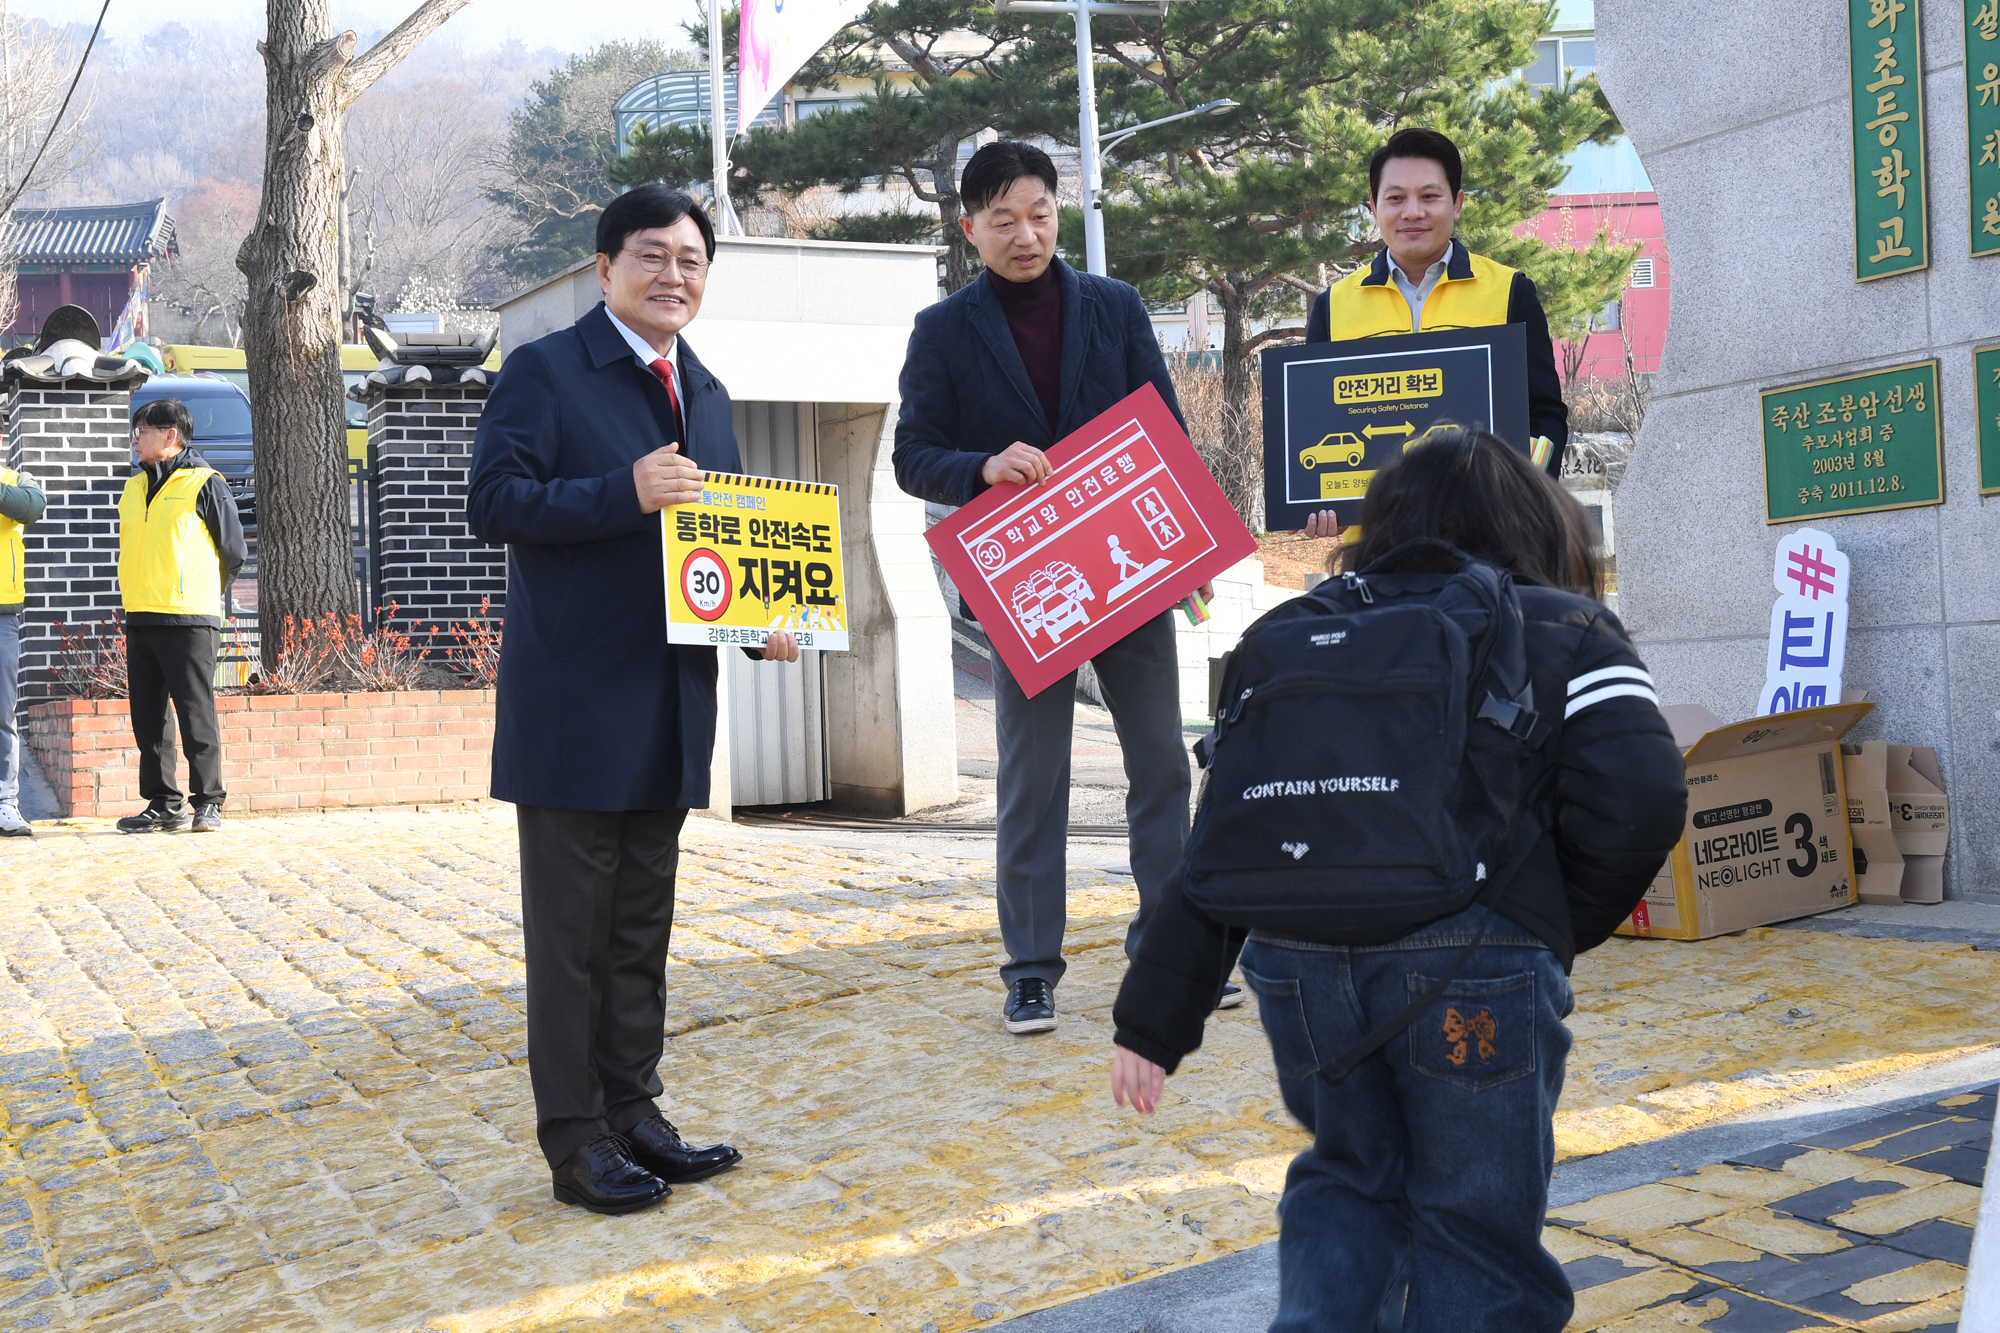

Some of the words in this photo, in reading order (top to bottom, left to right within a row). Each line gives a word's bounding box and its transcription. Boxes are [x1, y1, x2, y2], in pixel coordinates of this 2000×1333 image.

[1337, 377, 1401, 399] 안전거리
[1405, 373, 1438, 393] 확보
[1347, 405, 1377, 415] Securing
[1377, 403, 1399, 413] Safety
[1400, 401, 1429, 411] Distance
[1771, 402, 1811, 433] 죽산
[1801, 426, 1873, 453] 추모사업회
[1879, 423, 1894, 442] 증
[1813, 452, 1856, 475] 2003년
[1863, 449, 1886, 468] 8월
[1325, 479, 1350, 490] 오늘도
[1798, 485, 1824, 504] 증축
[1830, 475, 1906, 499] 2011.12.8.
[736, 494, 766, 511] 캠페인
[979, 544, 1002, 563] 30
[1005, 502, 1060, 545] 학교앞
[1065, 452, 1138, 508] 안전운행
[676, 510, 742, 546] 통학로
[748, 517, 832, 554] 안전속도
[693, 570, 720, 595] 30
[738, 557, 836, 606] 지켜요
[699, 599, 717, 608] Km/h
[1242, 780, 1316, 800] CONTAIN
[1319, 776, 1400, 795] YOURSELF
[1702, 812, 1718, 824] 밝고
[1719, 808, 1740, 821] 선명한
[1742, 803, 1763, 817] 형광펜
[1901, 803, 1913, 821] 3
[1694, 826, 1779, 866] 네오라이트
[1784, 812, 1818, 878] 3
[1818, 835, 1828, 849] 색
[1820, 850, 1838, 864] 세트
[1698, 858, 1781, 890] NEOLIGHT
